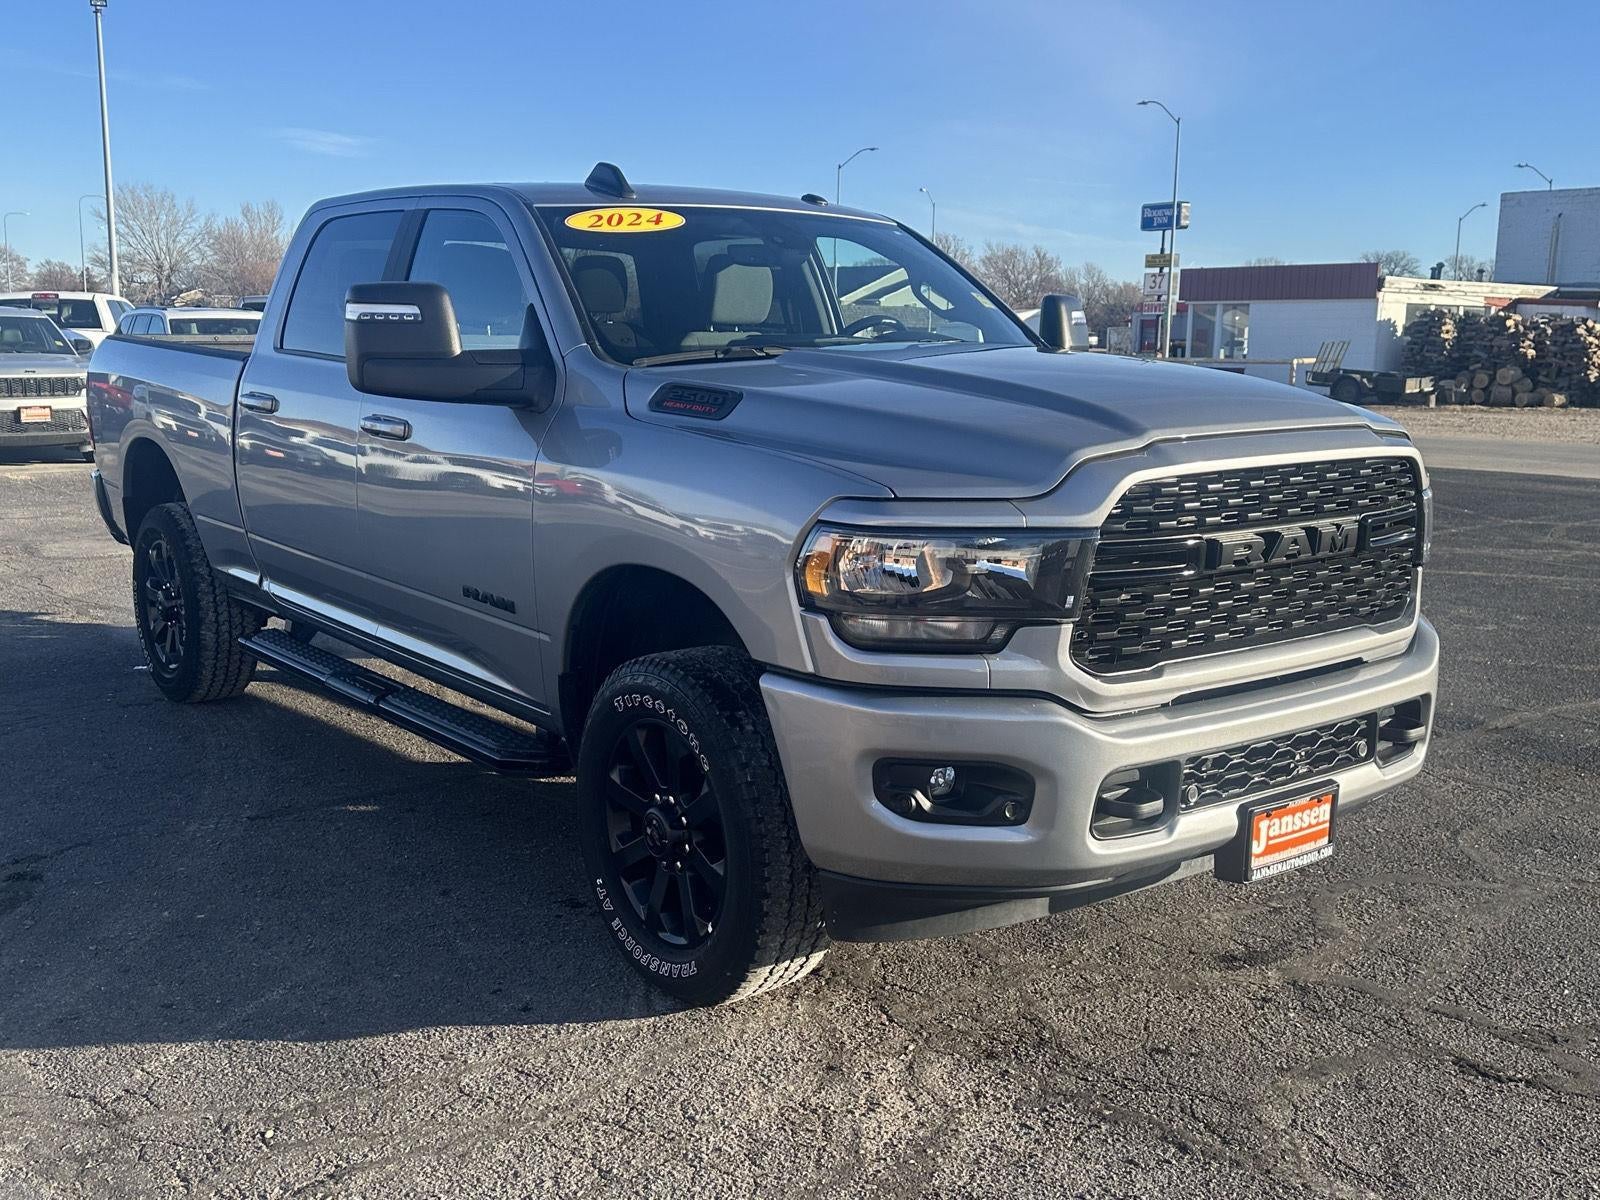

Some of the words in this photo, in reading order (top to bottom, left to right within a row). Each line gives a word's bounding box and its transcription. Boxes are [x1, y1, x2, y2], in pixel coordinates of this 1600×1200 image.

[588, 212, 663, 228] 2024
[1149, 273, 1165, 290] 37
[663, 401, 693, 409] HEAVY
[693, 404, 718, 413] DUTY
[1216, 521, 1359, 570] RAM
[462, 585, 516, 614] RAM
[613, 693, 710, 772] Firestone
[1251, 803, 1332, 855] Janssen
[1252, 846, 1334, 881] JANSSENAUTOGROUP.COM
[610, 916, 698, 978] TRANSFORCE
